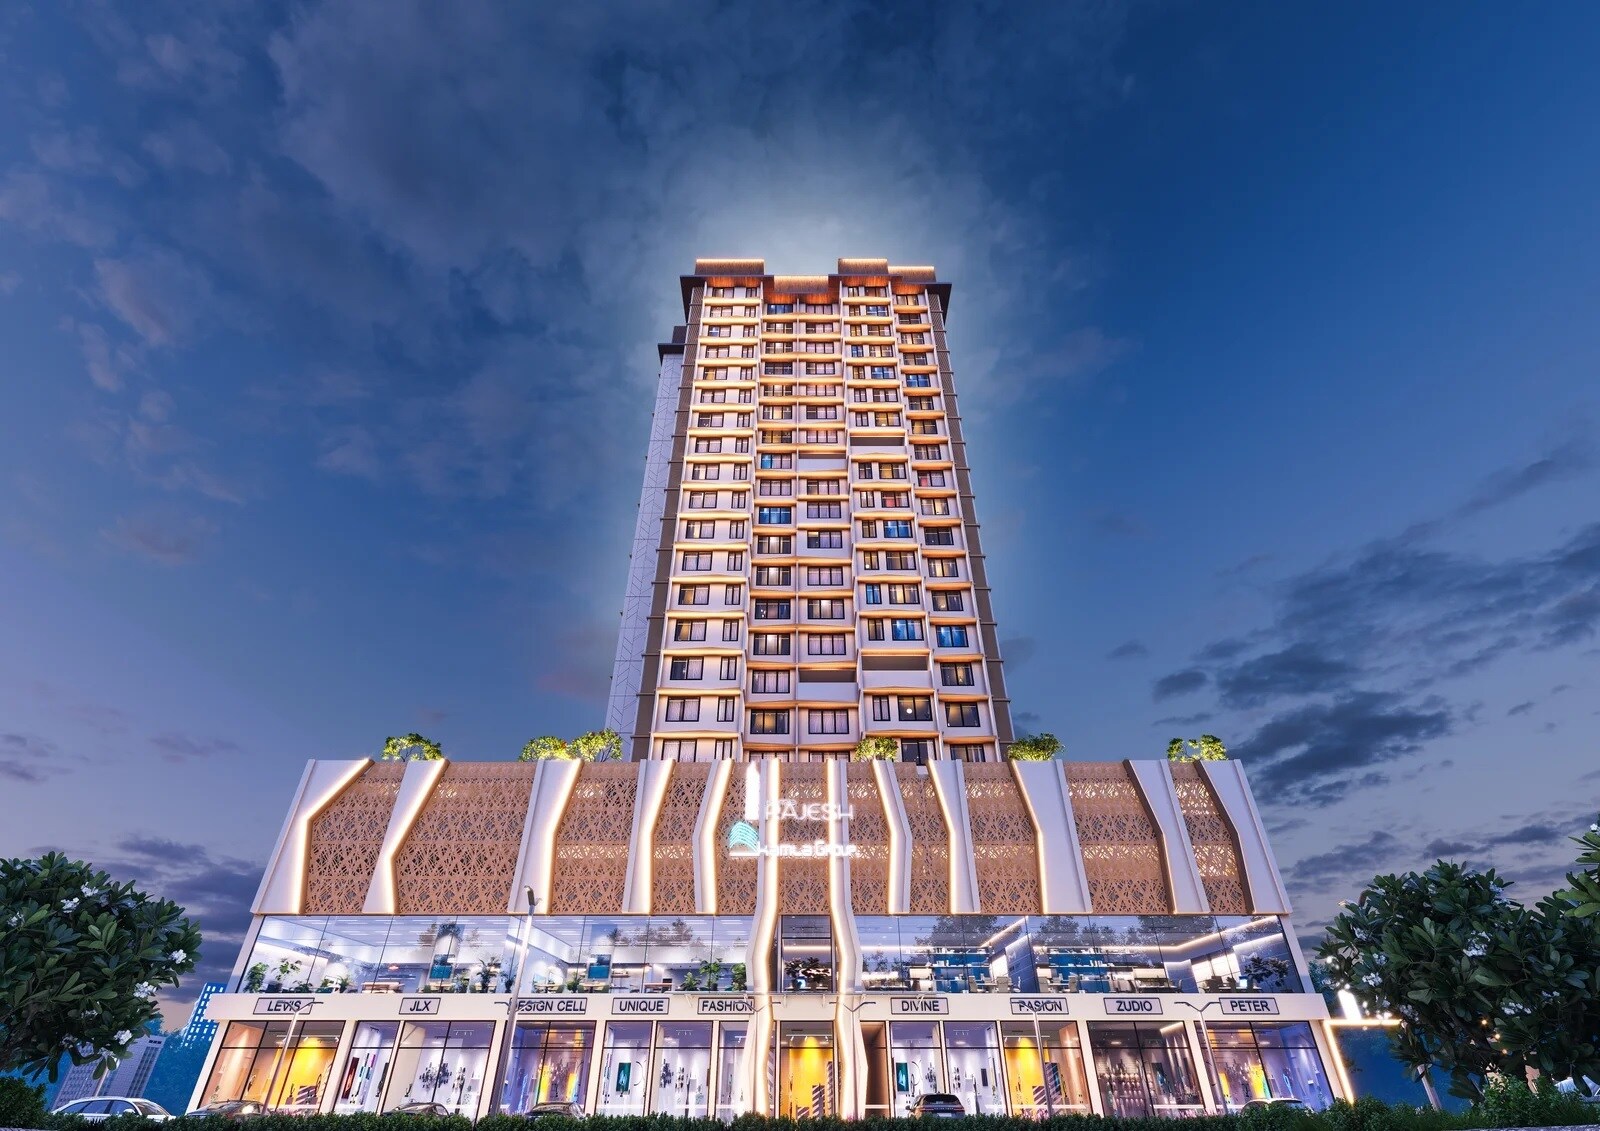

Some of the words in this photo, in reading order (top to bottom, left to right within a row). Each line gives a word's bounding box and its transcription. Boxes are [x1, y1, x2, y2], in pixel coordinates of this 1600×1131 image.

[409, 1000, 431, 1012] JLX
[511, 1000, 554, 1012] ESIGN
[557, 1000, 586, 1012] CELL
[619, 1000, 664, 1012] UNIQUE
[701, 1000, 753, 1012] FASHION
[901, 1000, 940, 1012] DIVINE
[1018, 1000, 1063, 1012] PASION
[1116, 1000, 1153, 1012] ZUDIO
[1230, 1000, 1271, 1012] PETER
